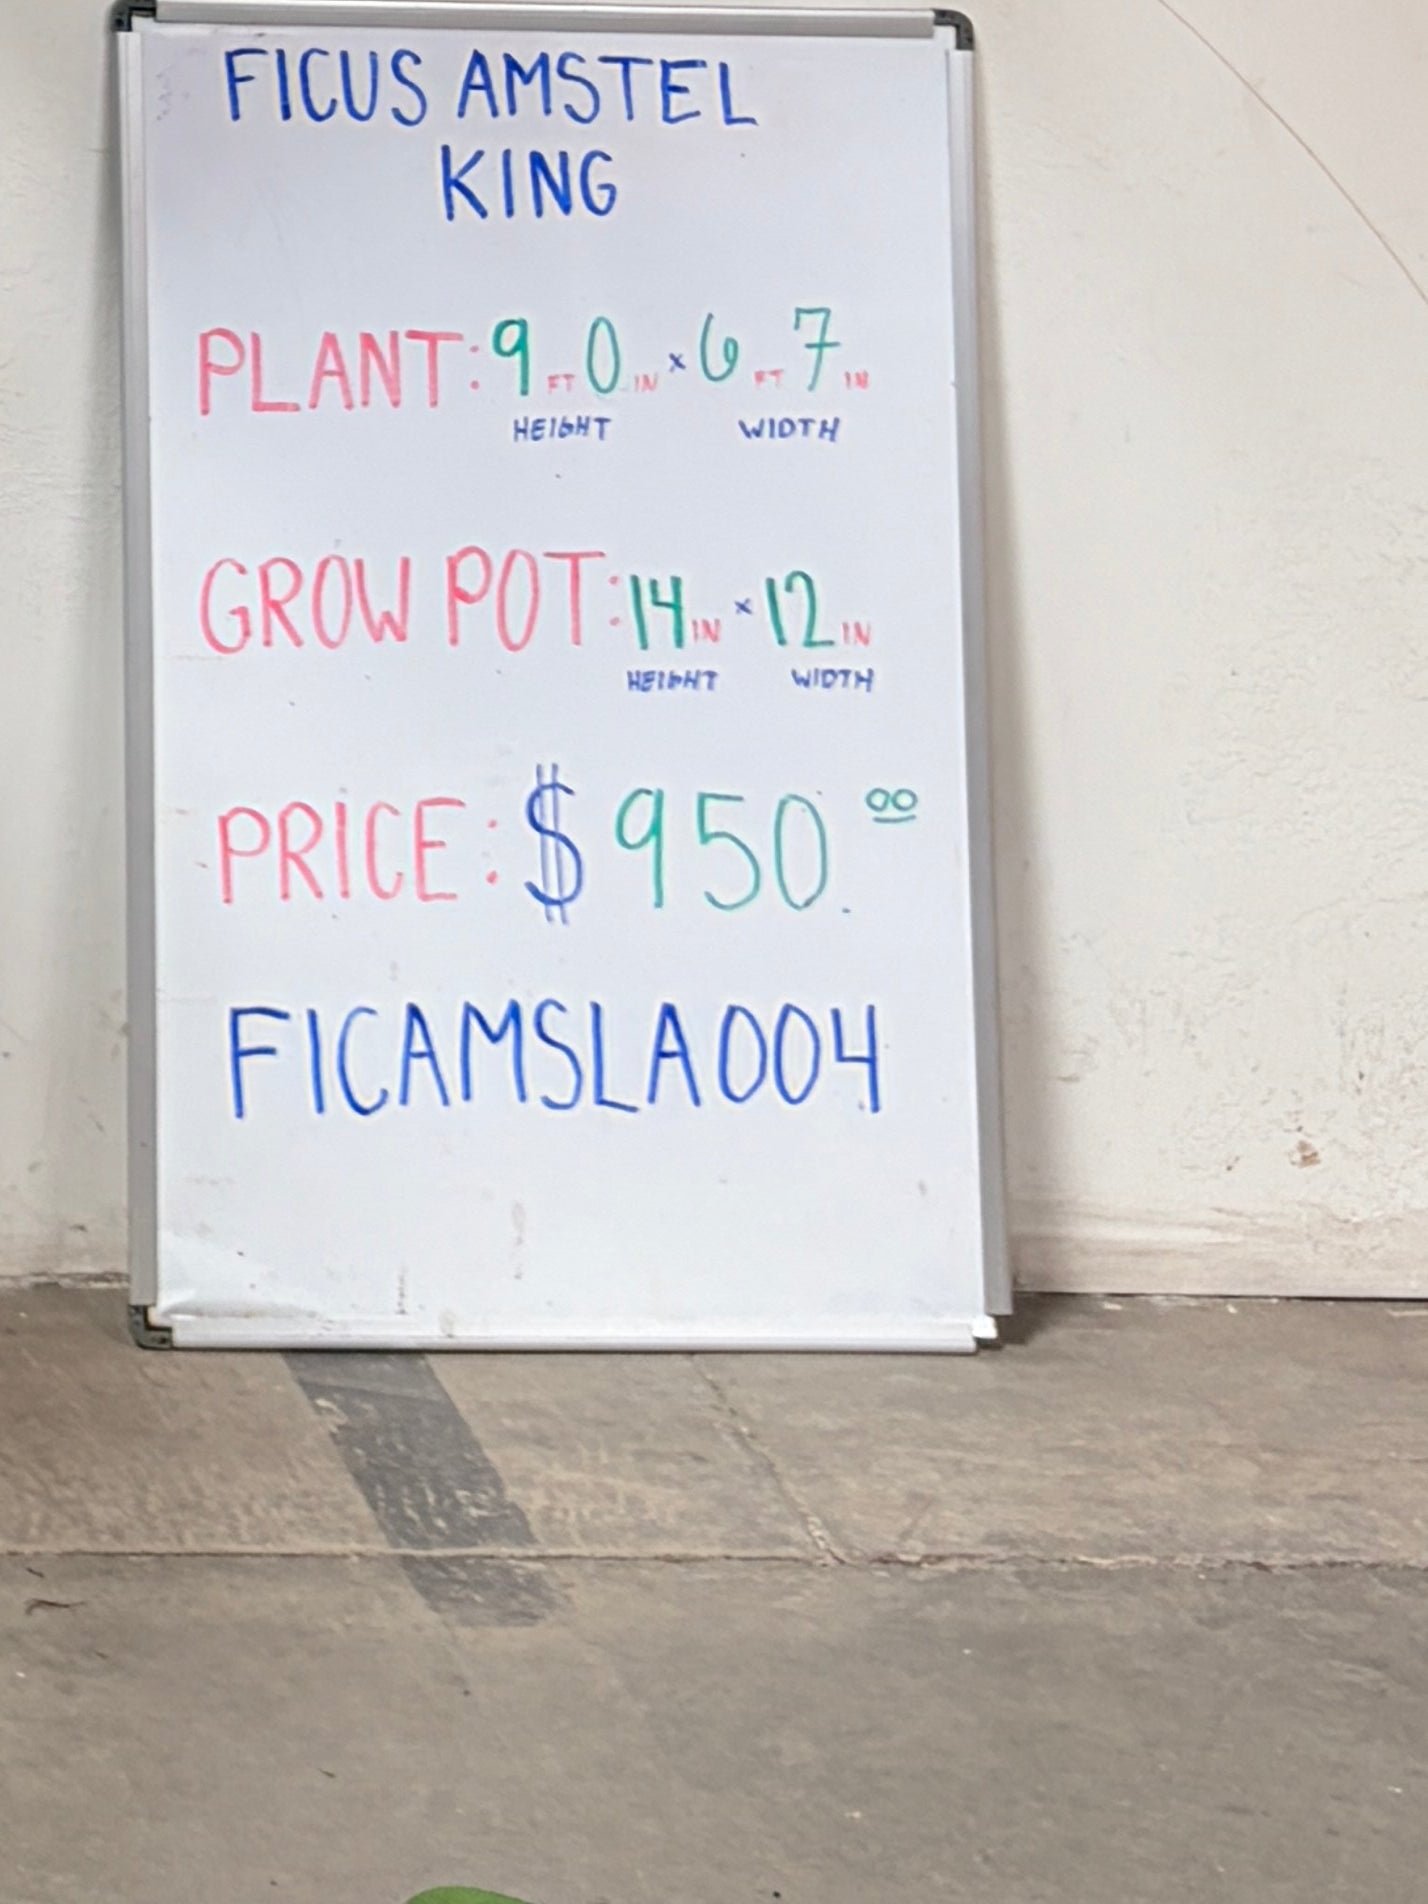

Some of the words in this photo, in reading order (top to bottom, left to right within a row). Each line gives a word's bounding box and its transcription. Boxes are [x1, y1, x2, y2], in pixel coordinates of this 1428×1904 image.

[222, 47, 430, 129] FICUS
[455, 49, 758, 129] AMSTEL
[439, 143, 619, 224] KING
[197, 327, 481, 417] PLANT:
[511, 415, 613, 445] HEIGHT
[738, 417, 841, 444] WIDTH
[198, 554, 412, 657] GROW
[445, 545, 622, 653] POT:
[625, 669, 719, 695] HEIGHT
[790, 667, 875, 694] WIDTH
[216, 797, 500, 906] PRICE:
[227, 996, 883, 1121] FICAMSLA004
